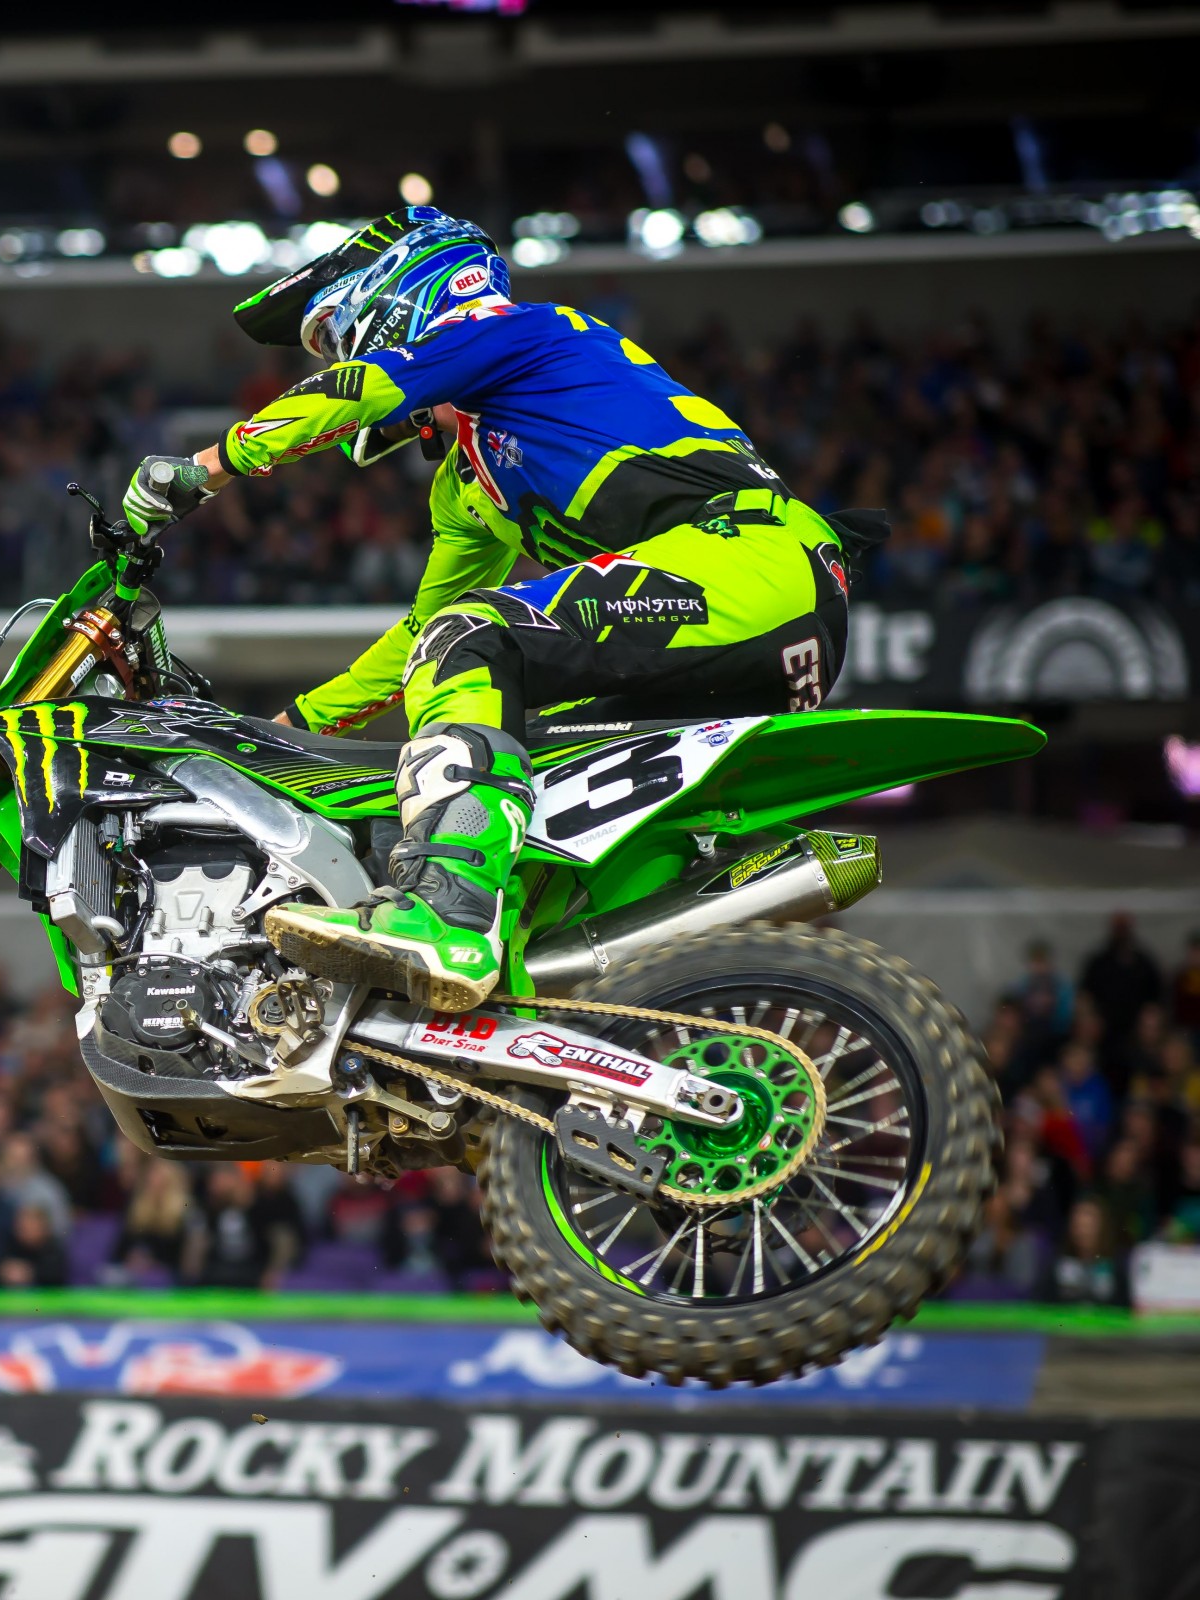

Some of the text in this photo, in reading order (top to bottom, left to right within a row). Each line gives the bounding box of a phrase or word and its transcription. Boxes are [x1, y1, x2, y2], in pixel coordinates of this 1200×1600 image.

[455, 271, 486, 291] BELL
[605, 596, 704, 615] MONSTER
[623, 614, 691, 623] ENERGY
[546, 721, 634, 734] Kawasaki
[691, 720, 734, 736] AMA
[544, 731, 684, 841] 3
[573, 824, 618, 849] TOMAC
[731, 842, 791, 889] CIRCUIT
[146, 985, 196, 996] Kawasaki
[453, 1037, 487, 1052] STAR
[53, 1400, 1085, 1513] ROCKY MOUNTAIN
